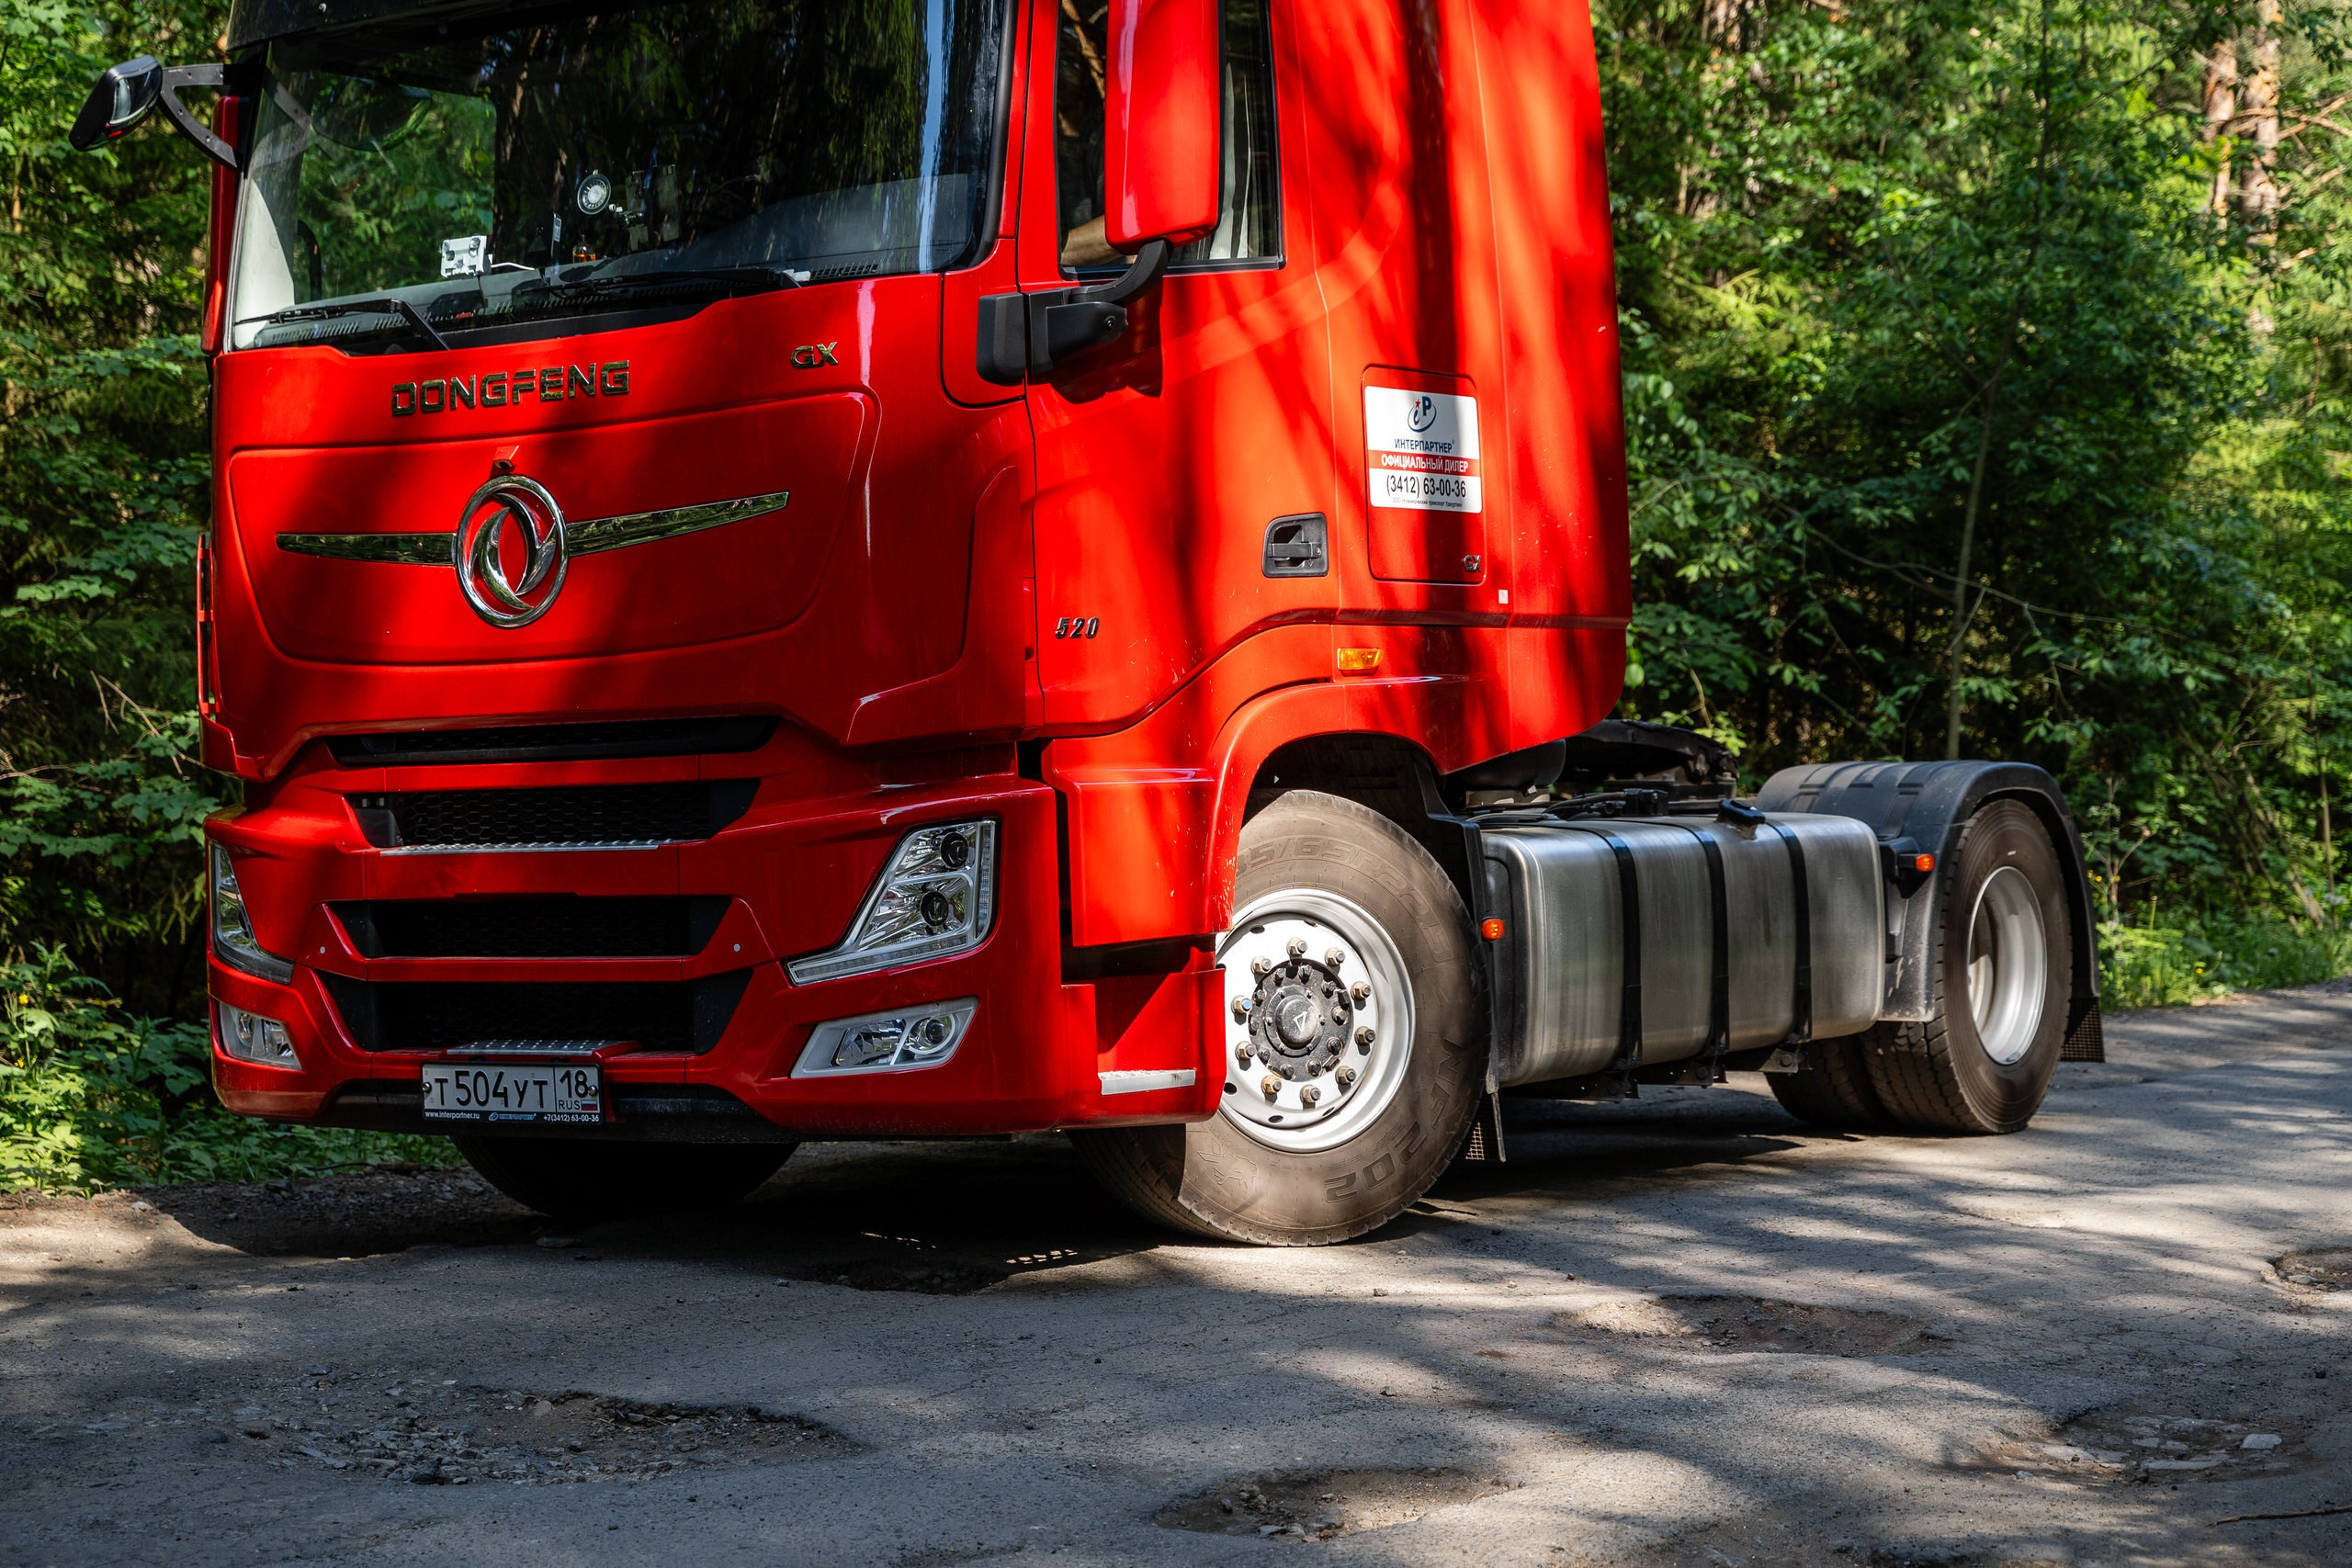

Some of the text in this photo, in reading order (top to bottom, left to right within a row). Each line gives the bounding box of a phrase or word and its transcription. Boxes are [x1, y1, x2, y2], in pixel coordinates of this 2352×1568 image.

[790, 341, 839, 368] GX
[391, 359, 630, 417] DONGFENG
[1395, 438, 1453, 454] ИНТЕРПАРТНЕР
[1381, 453, 1469, 473] ОФИЦИАЛЬНЫЙ ДИЛЕР
[1386, 474, 1466, 499] (3412) 63-00-36
[1463, 554, 1481, 572] GX
[1055, 616, 1100, 639] 520
[560, 1069, 589, 1099] 18
[558, 1100, 581, 1111] RUS
[571, 1113, 600, 1122] 63-00-36
